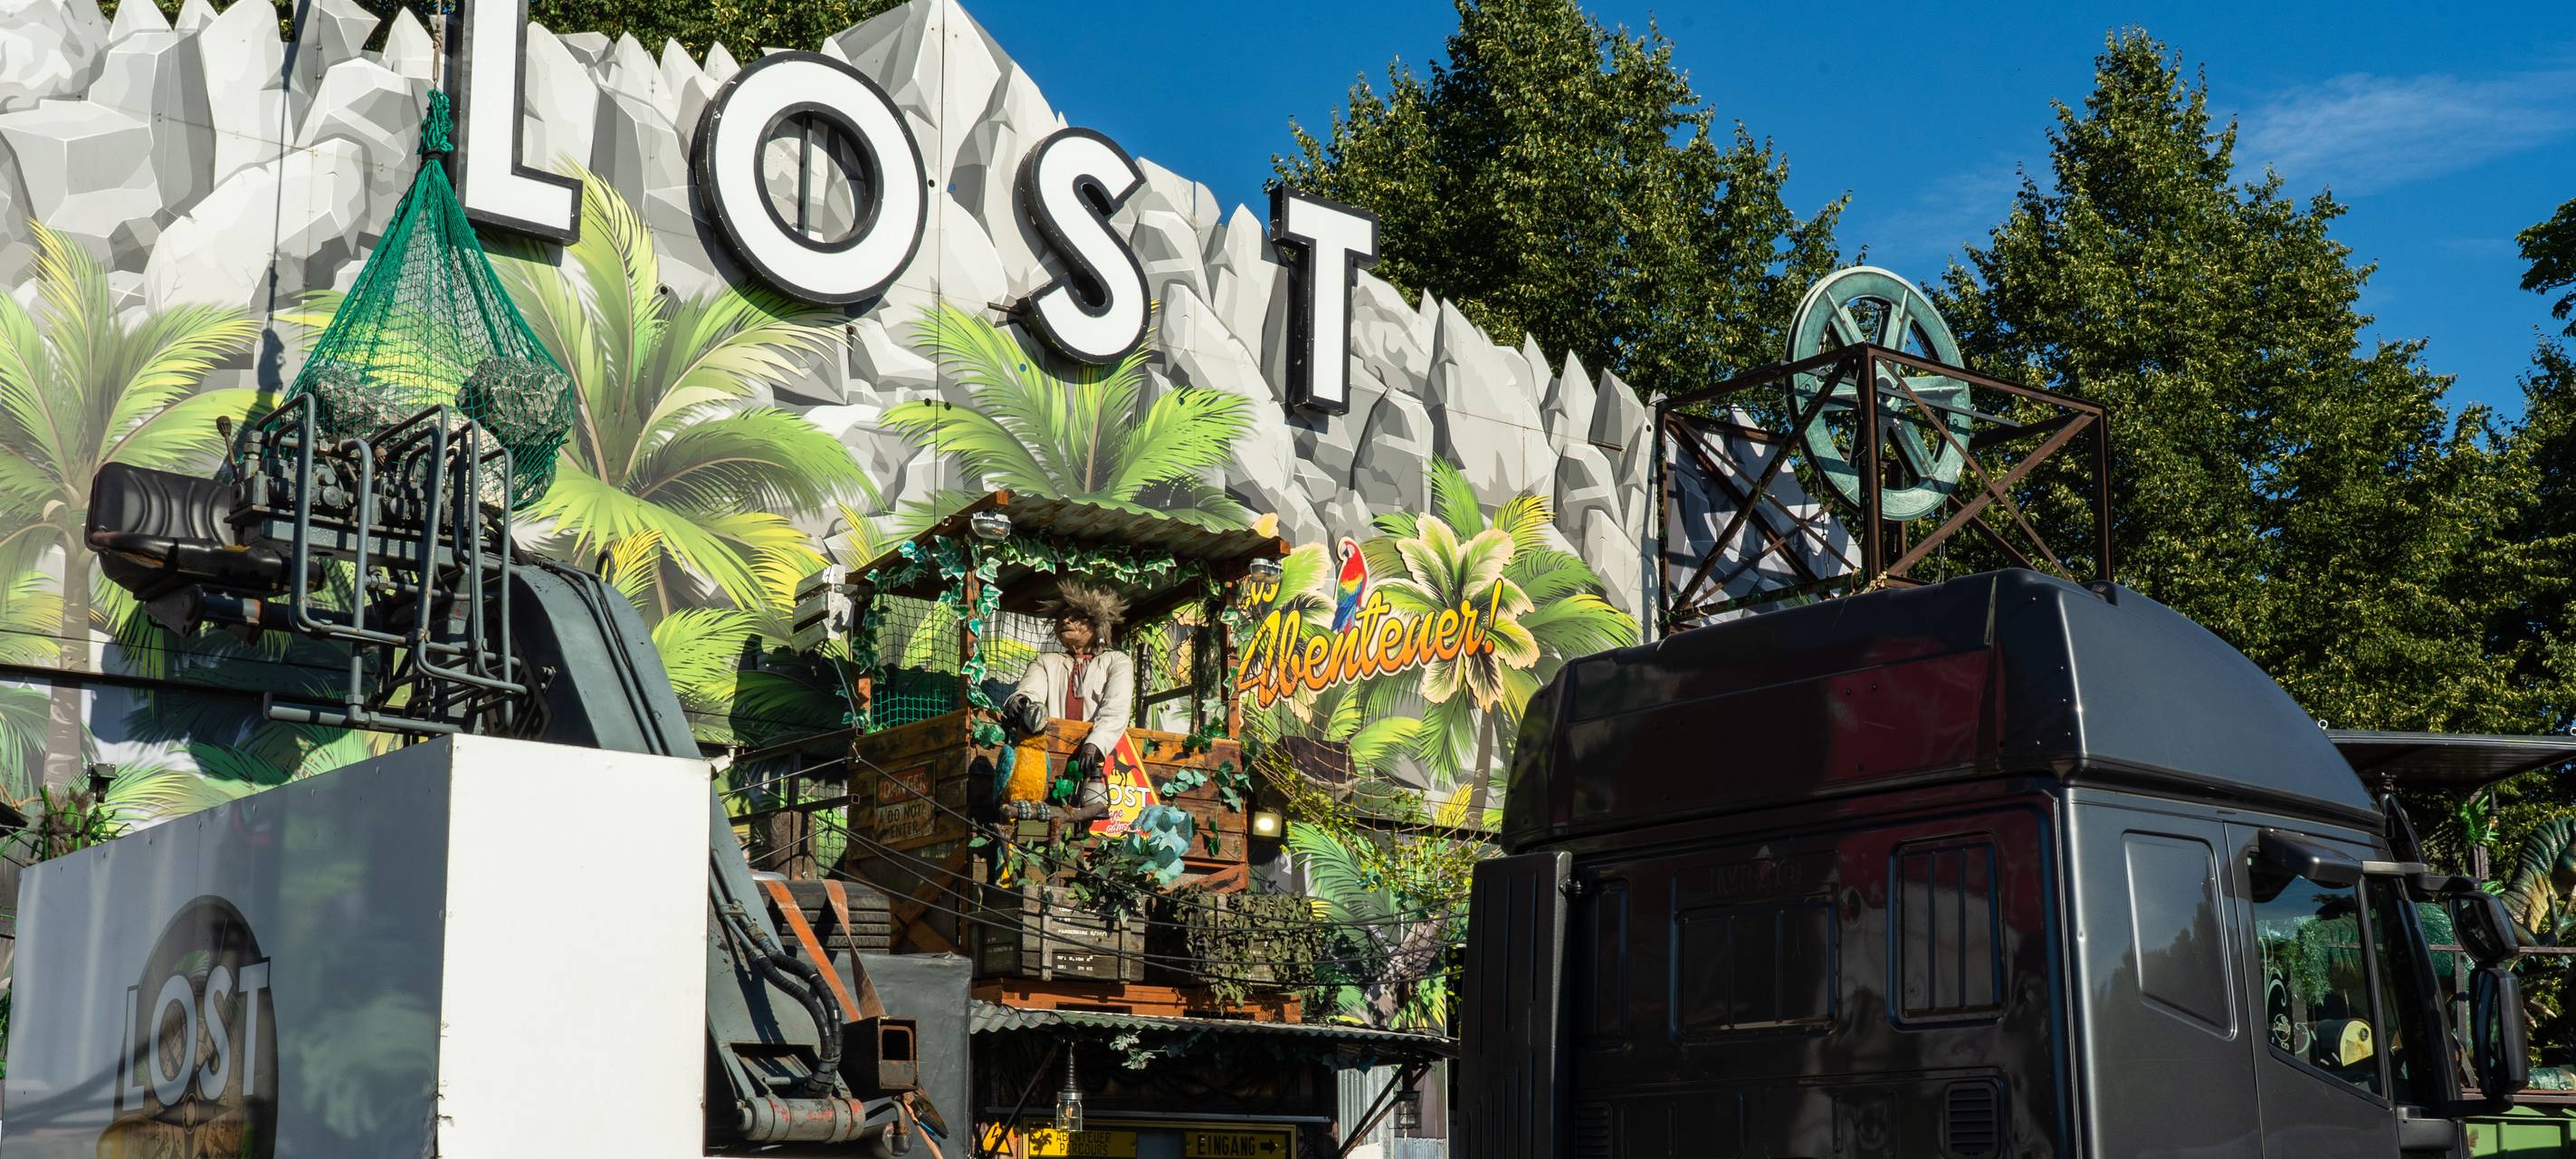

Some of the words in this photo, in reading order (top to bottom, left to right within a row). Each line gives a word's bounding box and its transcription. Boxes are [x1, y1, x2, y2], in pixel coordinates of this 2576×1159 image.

[453, 0, 1379, 416] LOST
[1237, 578, 1503, 708] Abenteuer!
[1105, 783, 1150, 808] OST
[887, 809, 901, 824] DO
[903, 803, 921, 819] NOT
[891, 819, 919, 838] ENTER
[122, 957, 271, 1112] LOST
[1056, 1132, 1111, 1145] ABENTEUER
[1059, 1143, 1109, 1156] PARCOURS
[1197, 1134, 1255, 1156] EINGANG
